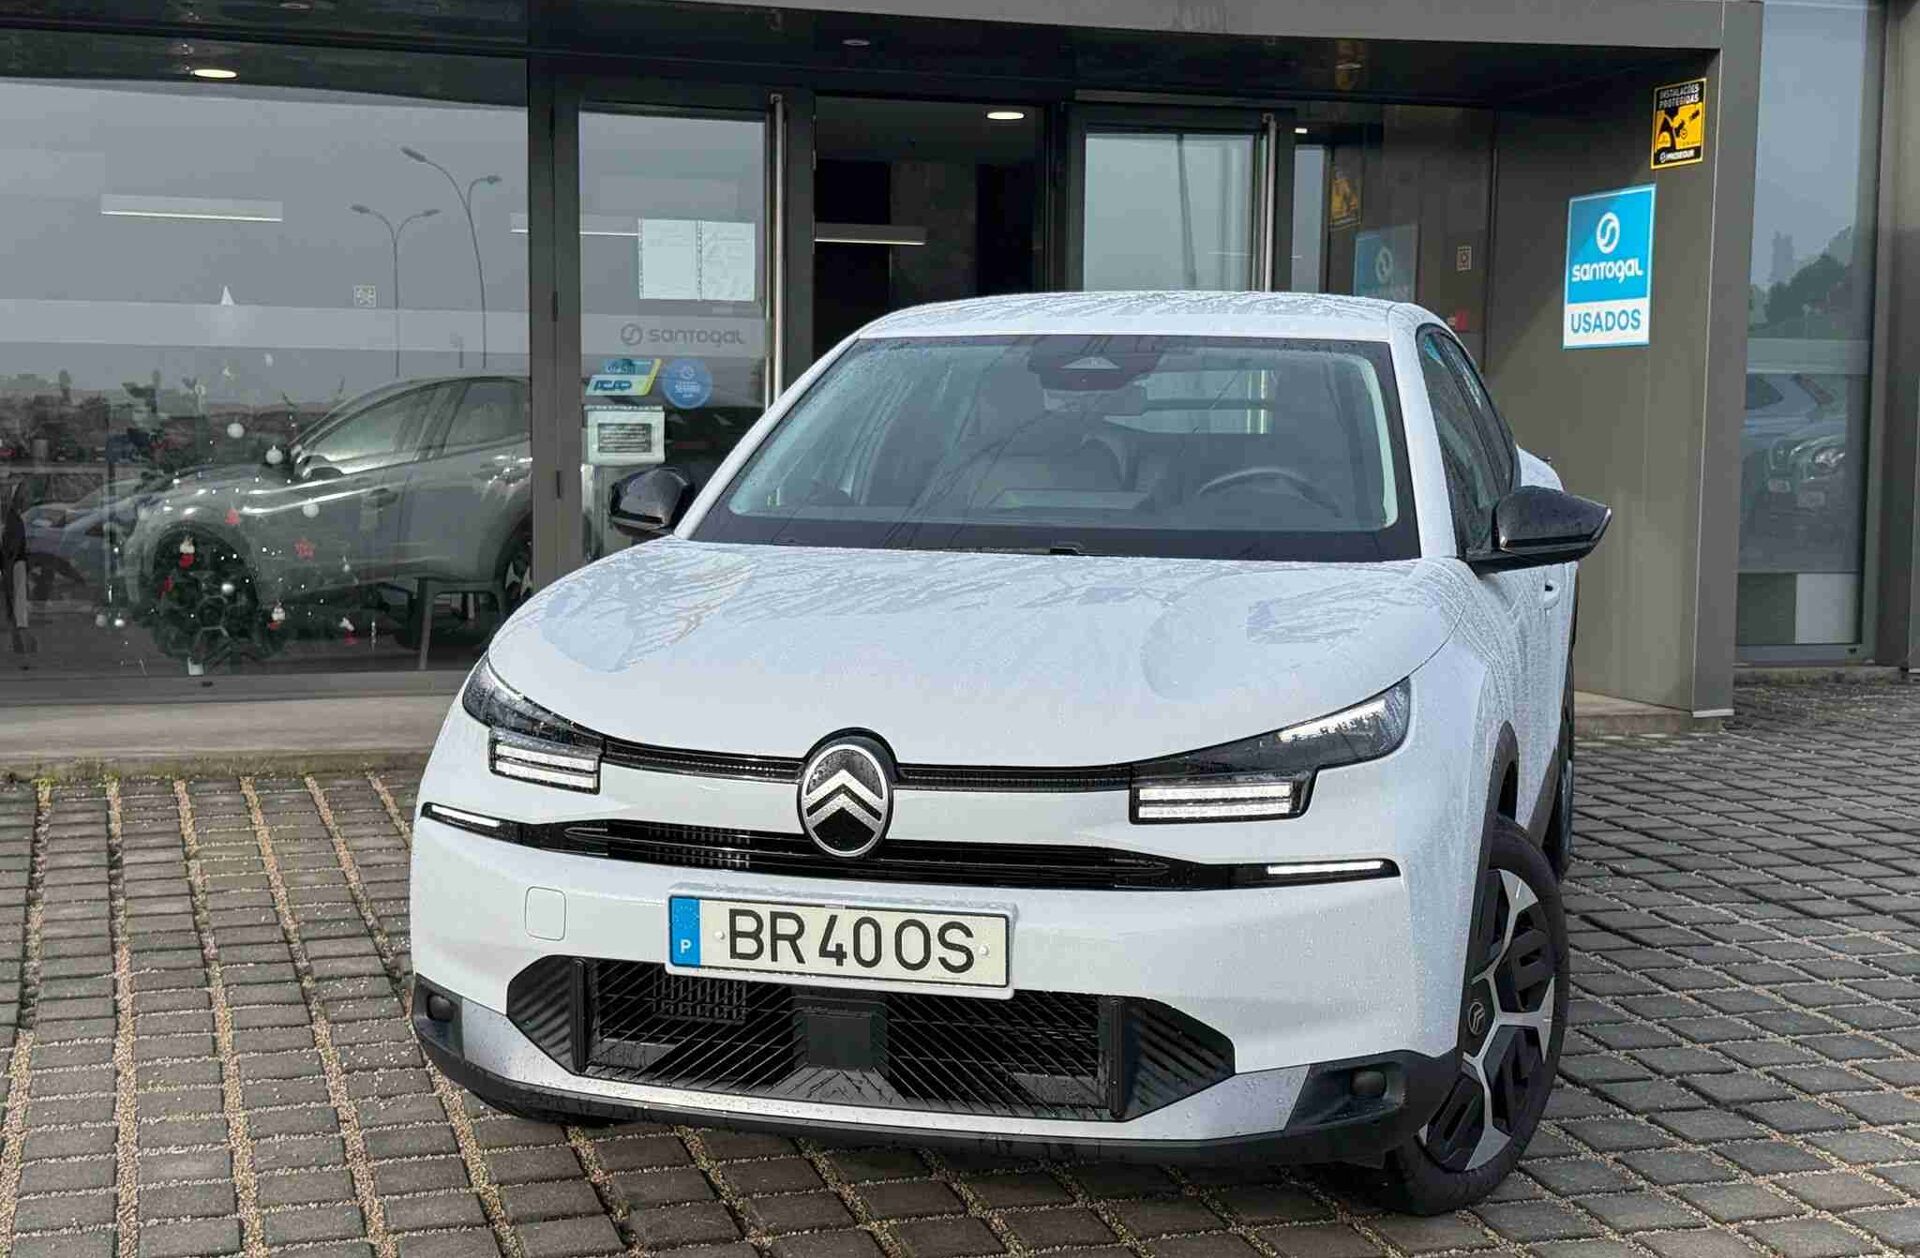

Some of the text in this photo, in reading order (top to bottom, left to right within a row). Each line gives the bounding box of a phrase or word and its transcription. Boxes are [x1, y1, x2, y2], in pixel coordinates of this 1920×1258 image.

[1571, 308, 1641, 334] USADOS
[680, 940, 691, 954] P
[728, 908, 975, 974] BR 40 OS
